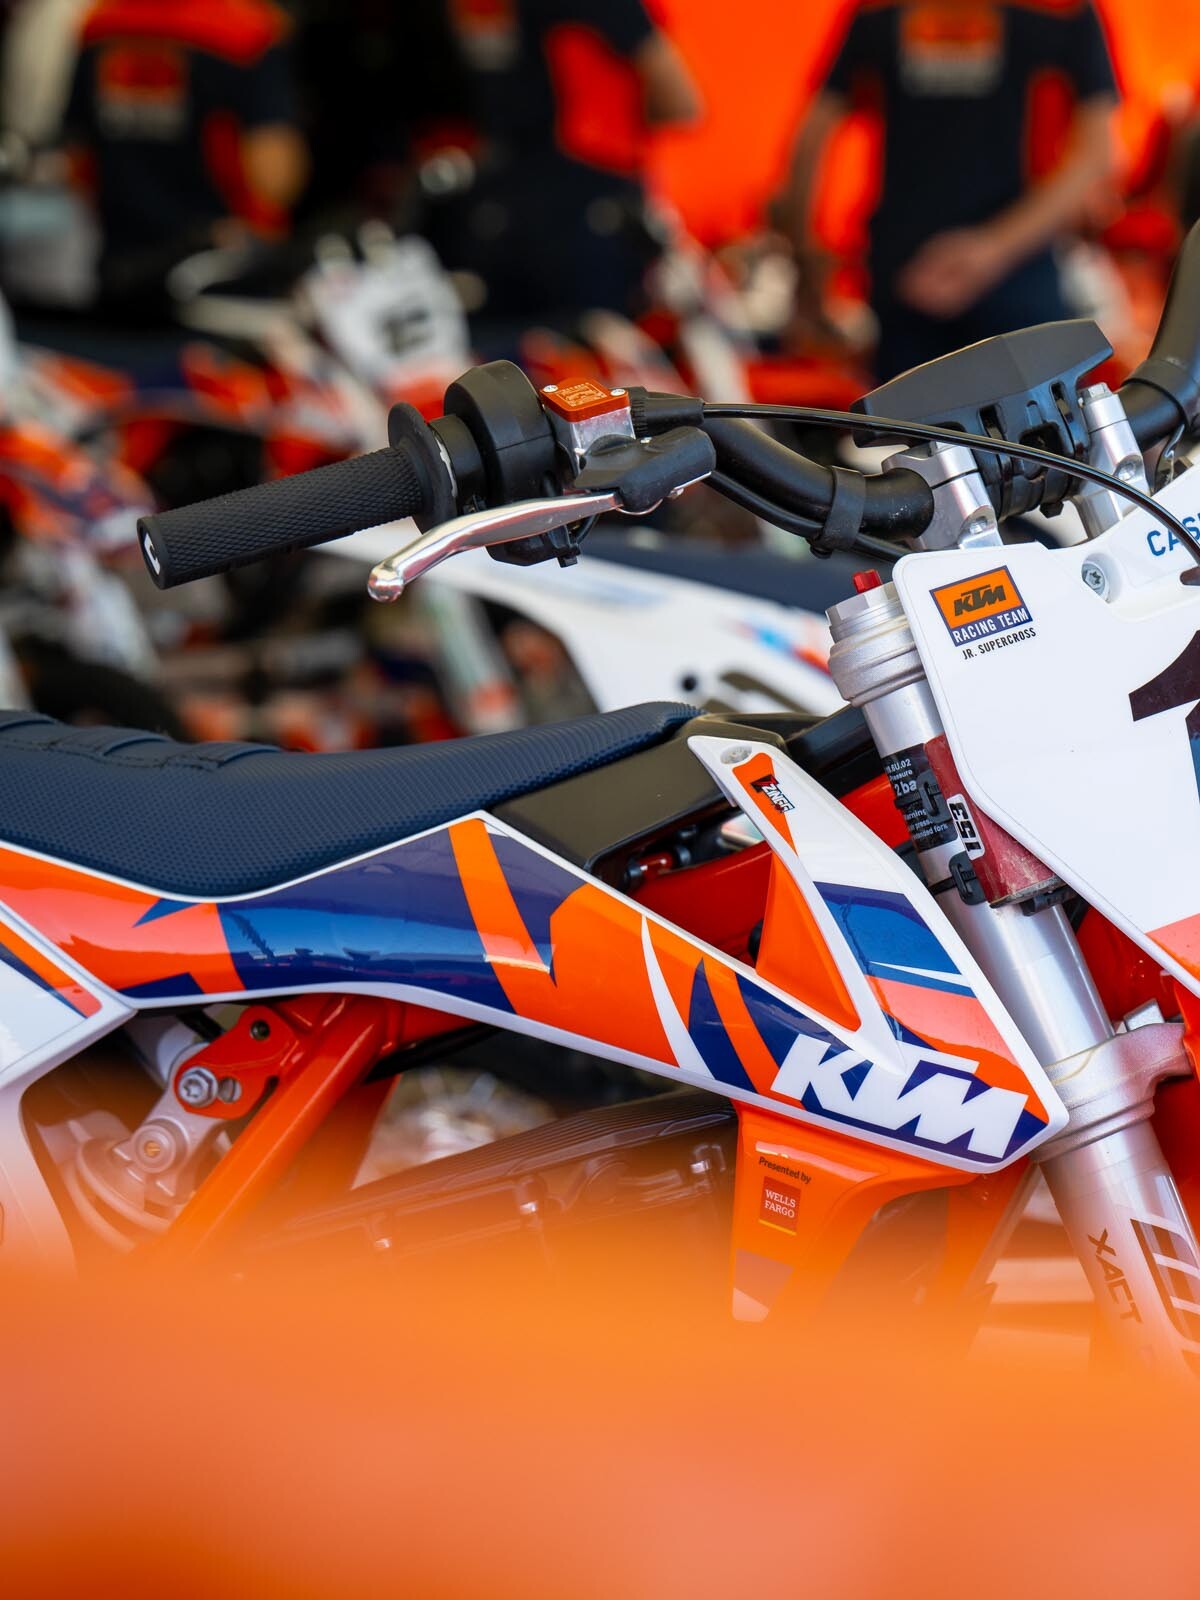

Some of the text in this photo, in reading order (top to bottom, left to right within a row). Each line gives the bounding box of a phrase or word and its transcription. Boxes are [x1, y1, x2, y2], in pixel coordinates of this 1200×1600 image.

[953, 583, 1007, 617] KTM
[952, 607, 1029, 643] RACING TEAM
[962, 627, 1037, 660] JR. SUPERCROSS
[948, 802, 982, 852] 153
[769, 1033, 1029, 1159] KTM
[758, 1155, 812, 1185] Presented by
[764, 1188, 797, 1208] WELLS
[764, 1199, 796, 1219] FARGO
[1087, 1227, 1144, 1325] XACT
